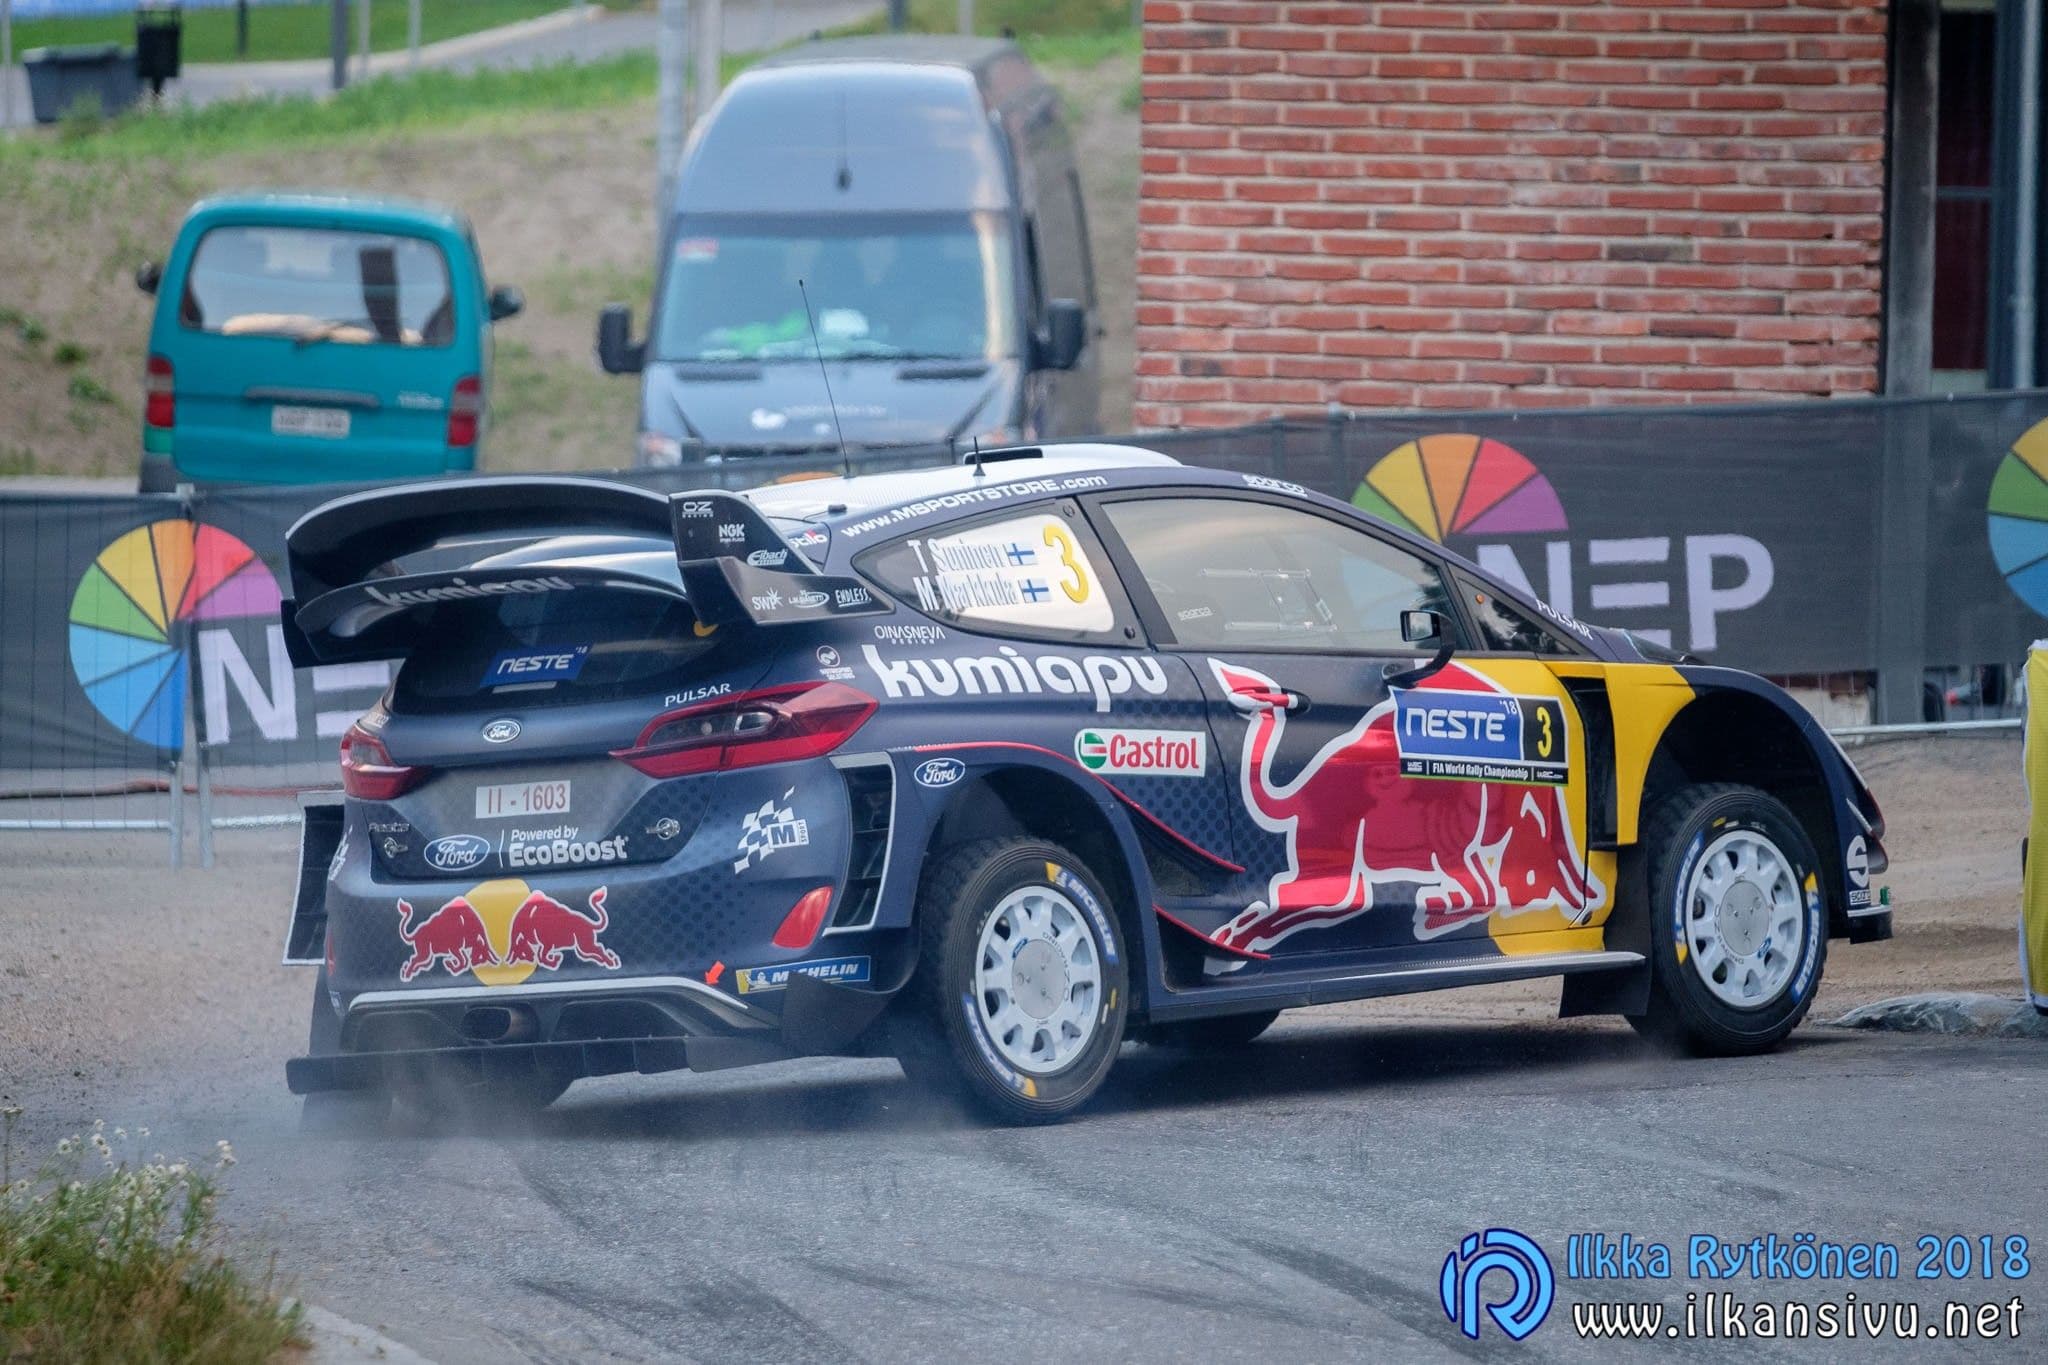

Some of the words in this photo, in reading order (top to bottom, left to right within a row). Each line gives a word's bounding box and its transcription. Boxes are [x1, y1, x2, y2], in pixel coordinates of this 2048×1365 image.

[683, 501, 713, 512] OZ
[841, 474, 1108, 537] www.MSPORTSTORE.com
[719, 524, 745, 538] NGK
[907, 539, 928, 573] T
[1043, 523, 1090, 604] 3
[912, 574, 940, 612] M
[1477, 533, 1775, 651] NEP
[874, 625, 946, 640] OINASNEVA
[1535, 598, 1594, 641] PULSAR
[497, 653, 574, 675] NESTE
[861, 644, 1168, 712] kumiapu
[664, 682, 731, 707] PULSAR
[1405, 707, 1506, 742] NESTE
[1536, 706, 1553, 758] 3
[1110, 734, 1199, 770] Castrol
[923, 761, 957, 783] Ford
[1432, 762, 1445, 774] FIA
[1445, 763, 1465, 776] World
[1466, 764, 1482, 778] Rally
[1484, 766, 1529, 780] Championship
[511, 827, 562, 842] Powered
[564, 825, 579, 841] by
[435, 839, 479, 866] Ford
[508, 835, 629, 868] EcoBoost
[770, 963, 860, 984] MHELIN
